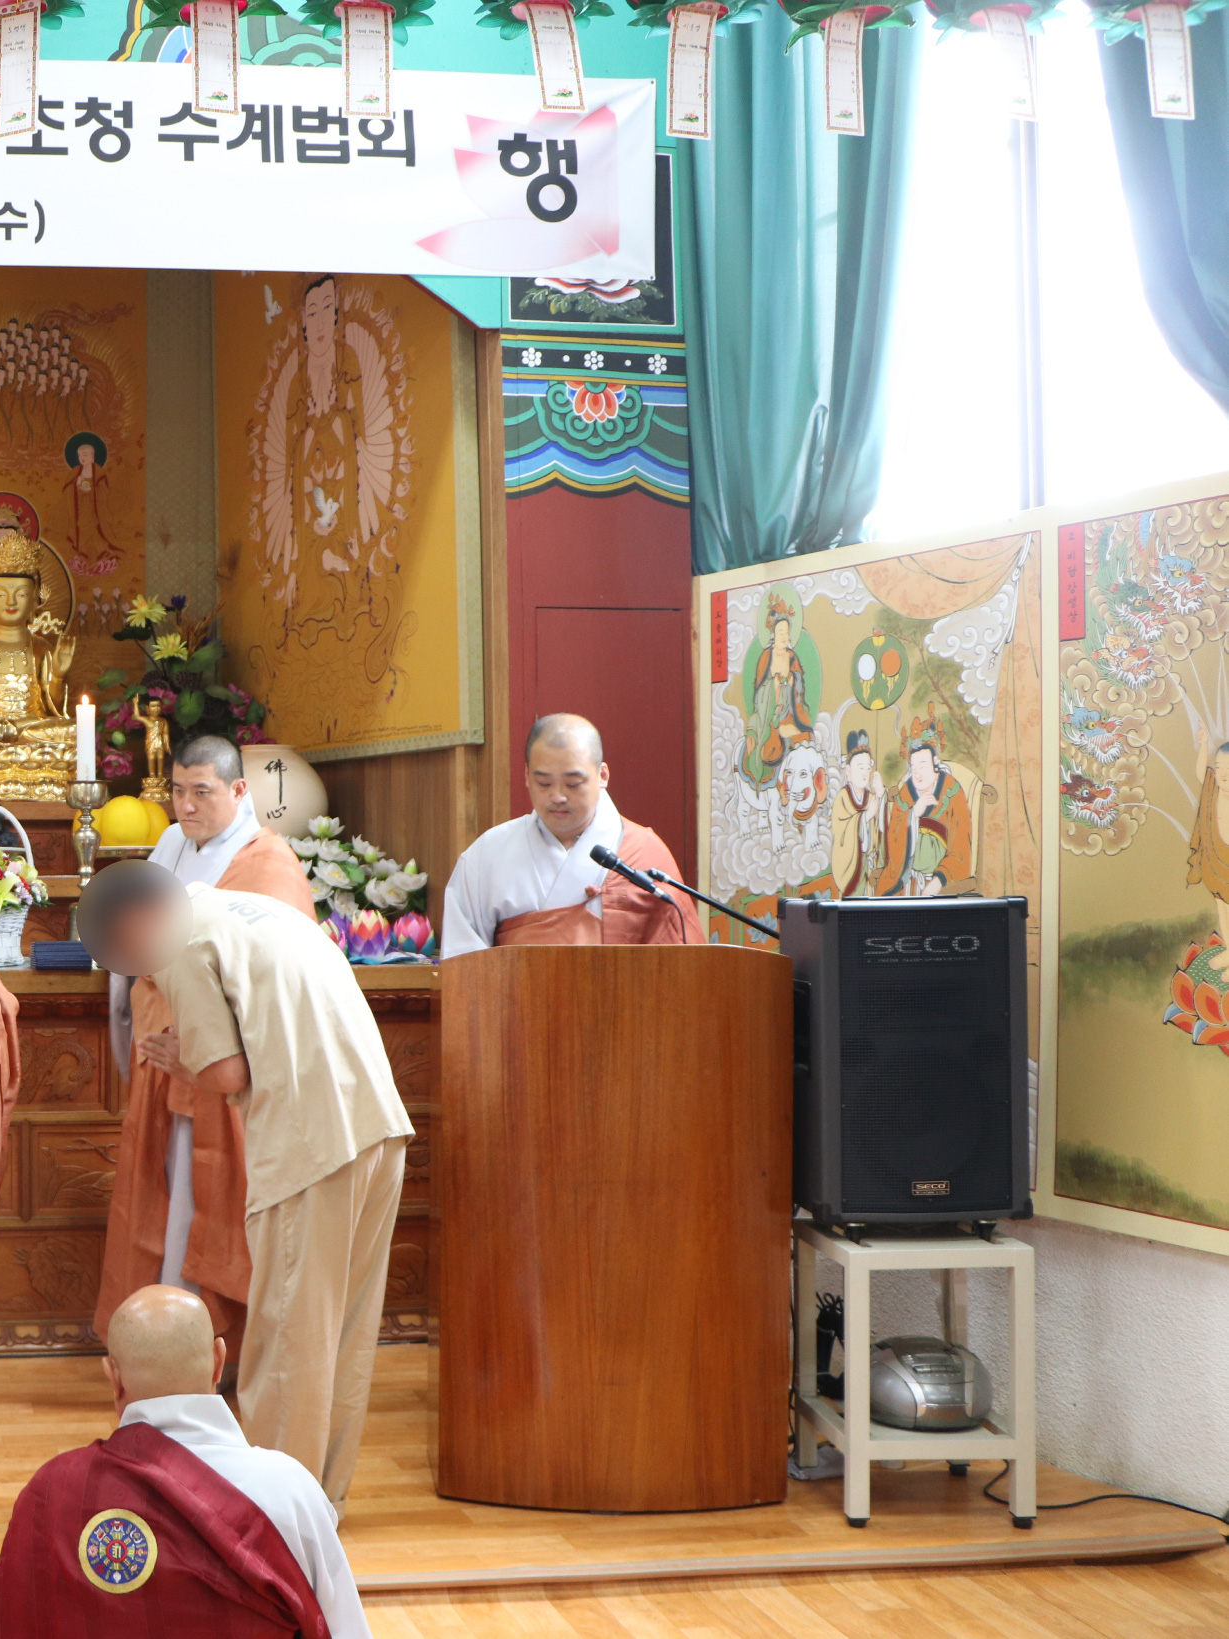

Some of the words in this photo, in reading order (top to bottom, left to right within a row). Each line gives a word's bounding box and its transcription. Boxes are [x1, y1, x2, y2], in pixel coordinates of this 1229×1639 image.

[158, 103, 417, 168] 수계법회
[498, 133, 578, 223] 행
[864, 935, 980, 955] SECO
